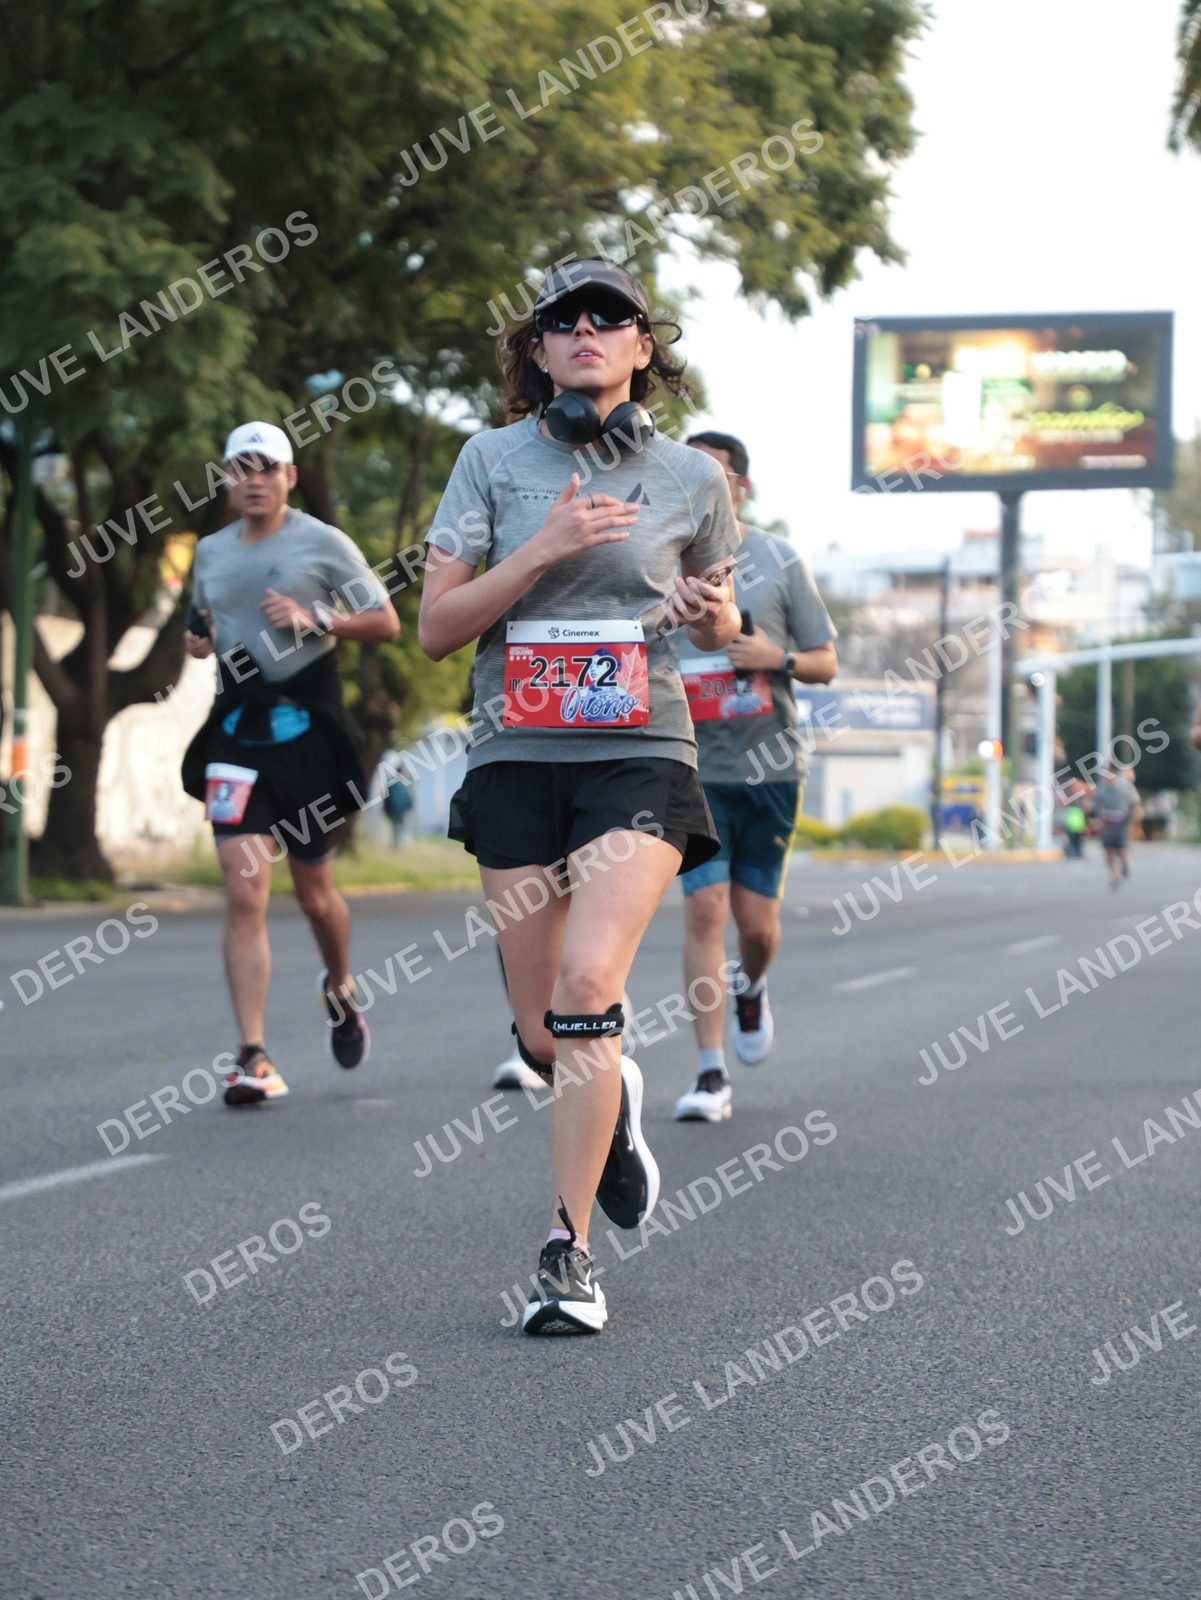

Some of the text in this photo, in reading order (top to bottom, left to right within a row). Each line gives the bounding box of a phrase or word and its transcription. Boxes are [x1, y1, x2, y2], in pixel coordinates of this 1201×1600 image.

[562, 628, 600, 637] Cinemex
[529, 655, 618, 688] 2172
[557, 1021, 617, 1031] MUELLER
